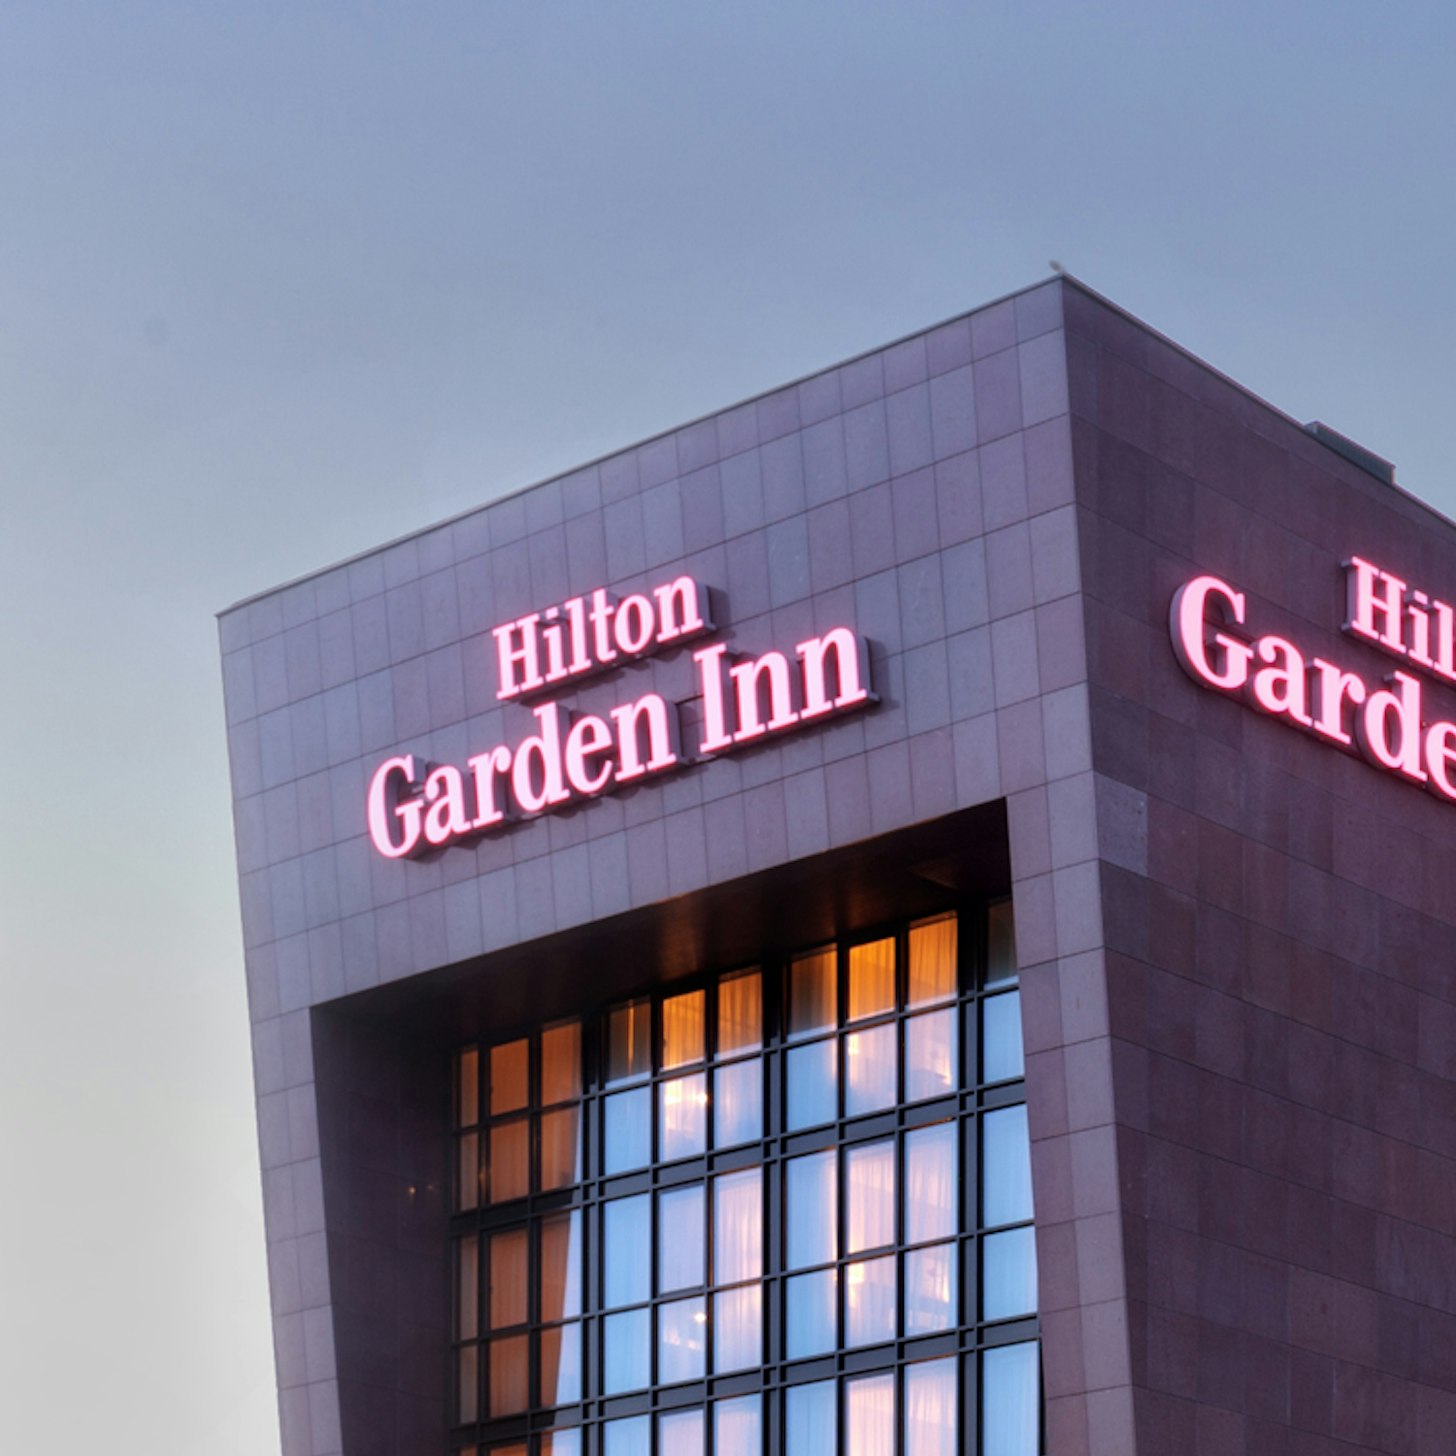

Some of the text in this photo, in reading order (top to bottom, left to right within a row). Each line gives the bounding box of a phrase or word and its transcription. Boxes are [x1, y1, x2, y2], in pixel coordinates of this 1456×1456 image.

[492, 575, 705, 700] Hilton
[367, 627, 867, 859] Garden Inn
